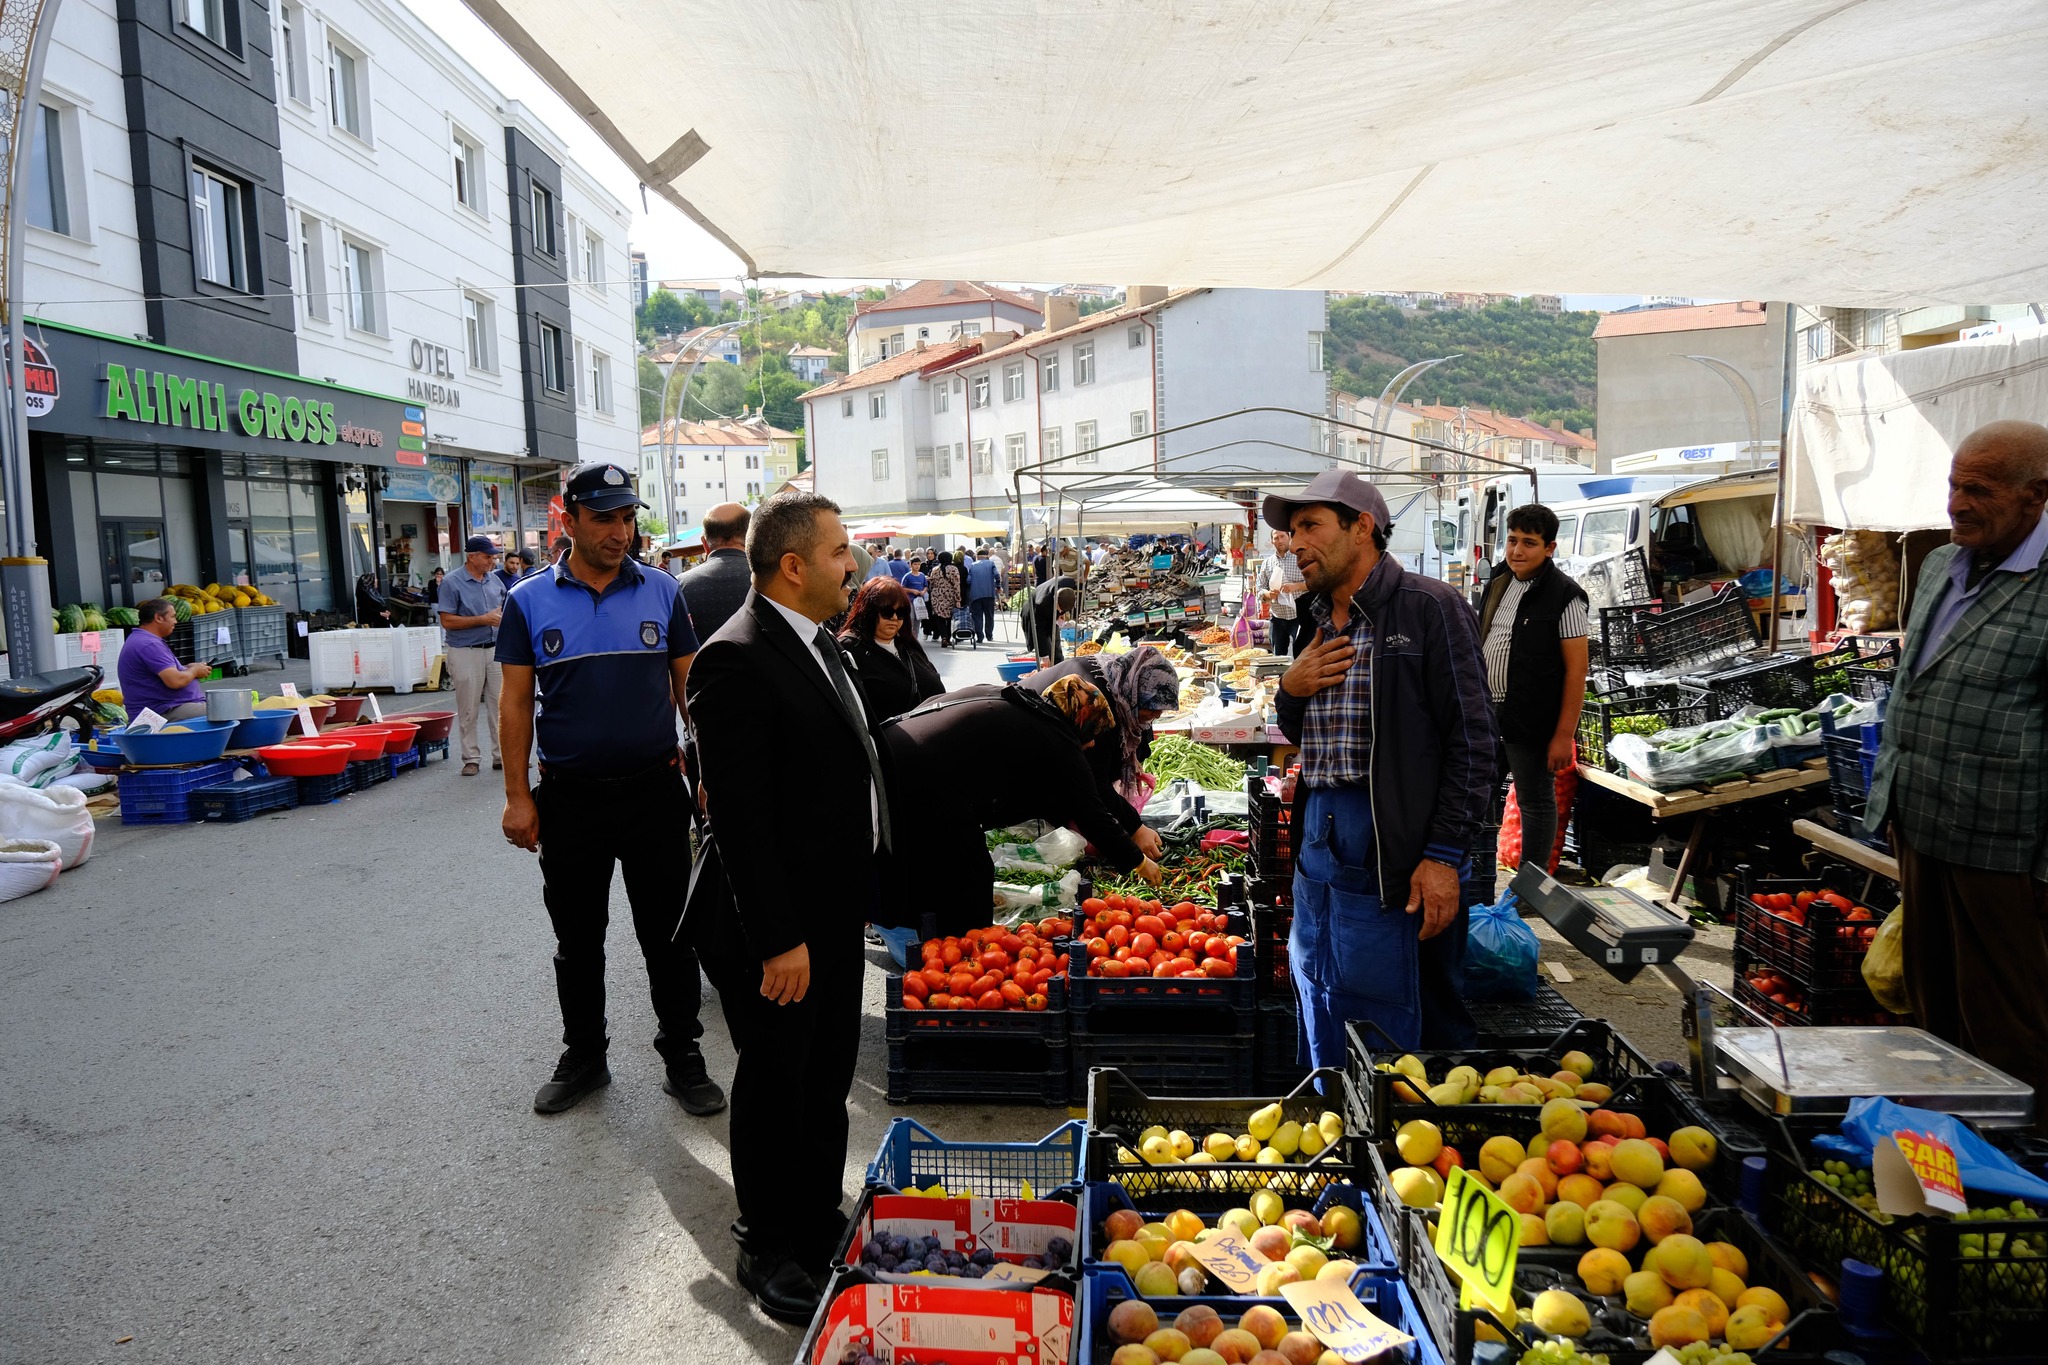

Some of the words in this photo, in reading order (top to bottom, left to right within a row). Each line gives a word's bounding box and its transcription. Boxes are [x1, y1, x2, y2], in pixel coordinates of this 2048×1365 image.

[411, 338, 455, 380] OTEL
[26, 395, 45, 409] OSS
[106, 363, 229, 432] ALIMLI
[238, 388, 337, 445] GROSS
[341, 420, 384, 450] ekspres
[407, 378, 460, 408] HANEDAN
[1684, 447, 1715, 459] BEST
[1896, 1138, 1959, 1177] SARI
[1449, 1175, 1514, 1287] 100
[1203, 1257, 1251, 1284] 100
[1306, 1300, 1367, 1335] 100
